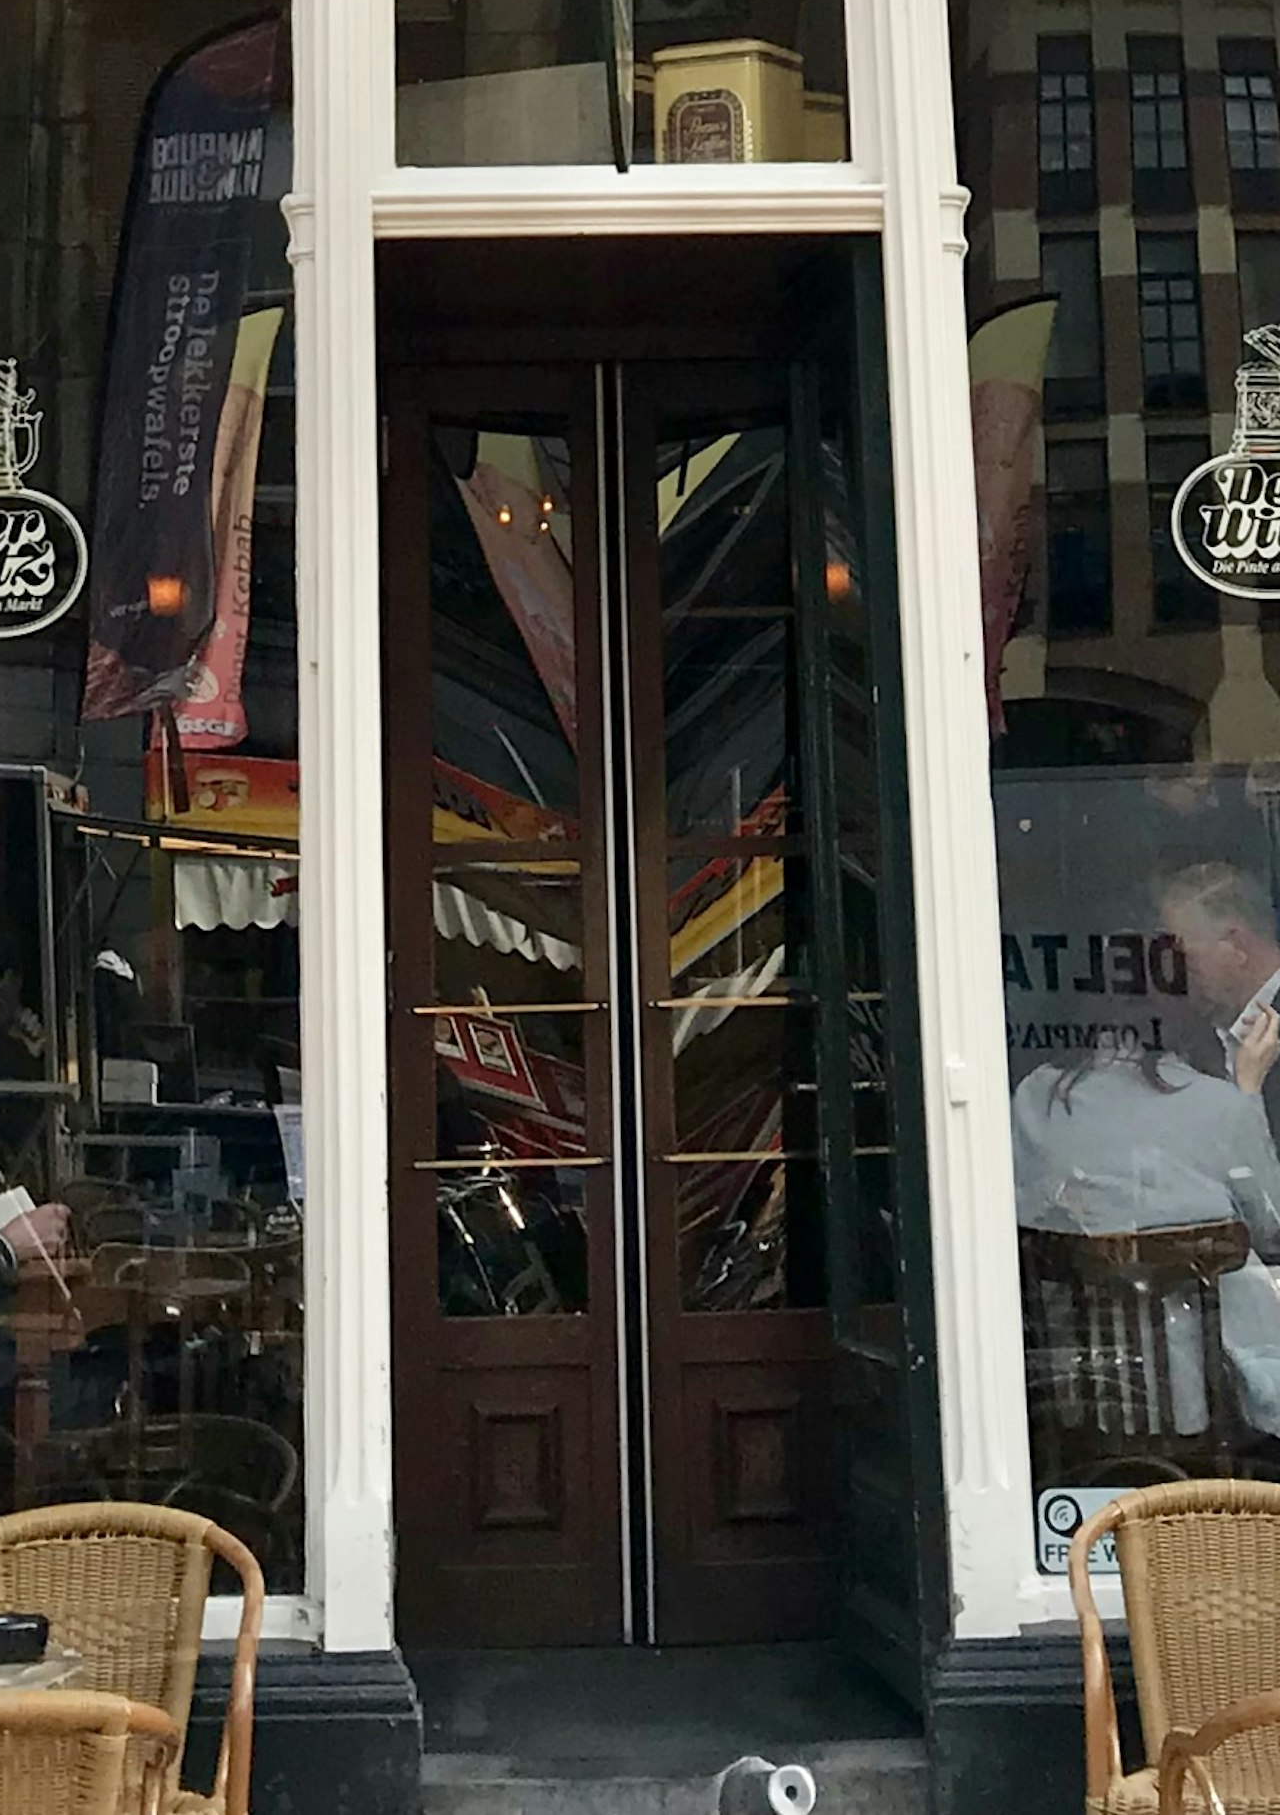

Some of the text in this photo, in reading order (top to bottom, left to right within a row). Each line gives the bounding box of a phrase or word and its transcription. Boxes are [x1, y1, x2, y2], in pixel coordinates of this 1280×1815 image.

[139, 274, 191, 509] stroopwafels.
[172, 325, 217, 497] lekkerste
[5, 598, 45, 613] Markt
[233, 514, 253, 617] Kebab
[1212, 559, 1233, 574] Die
